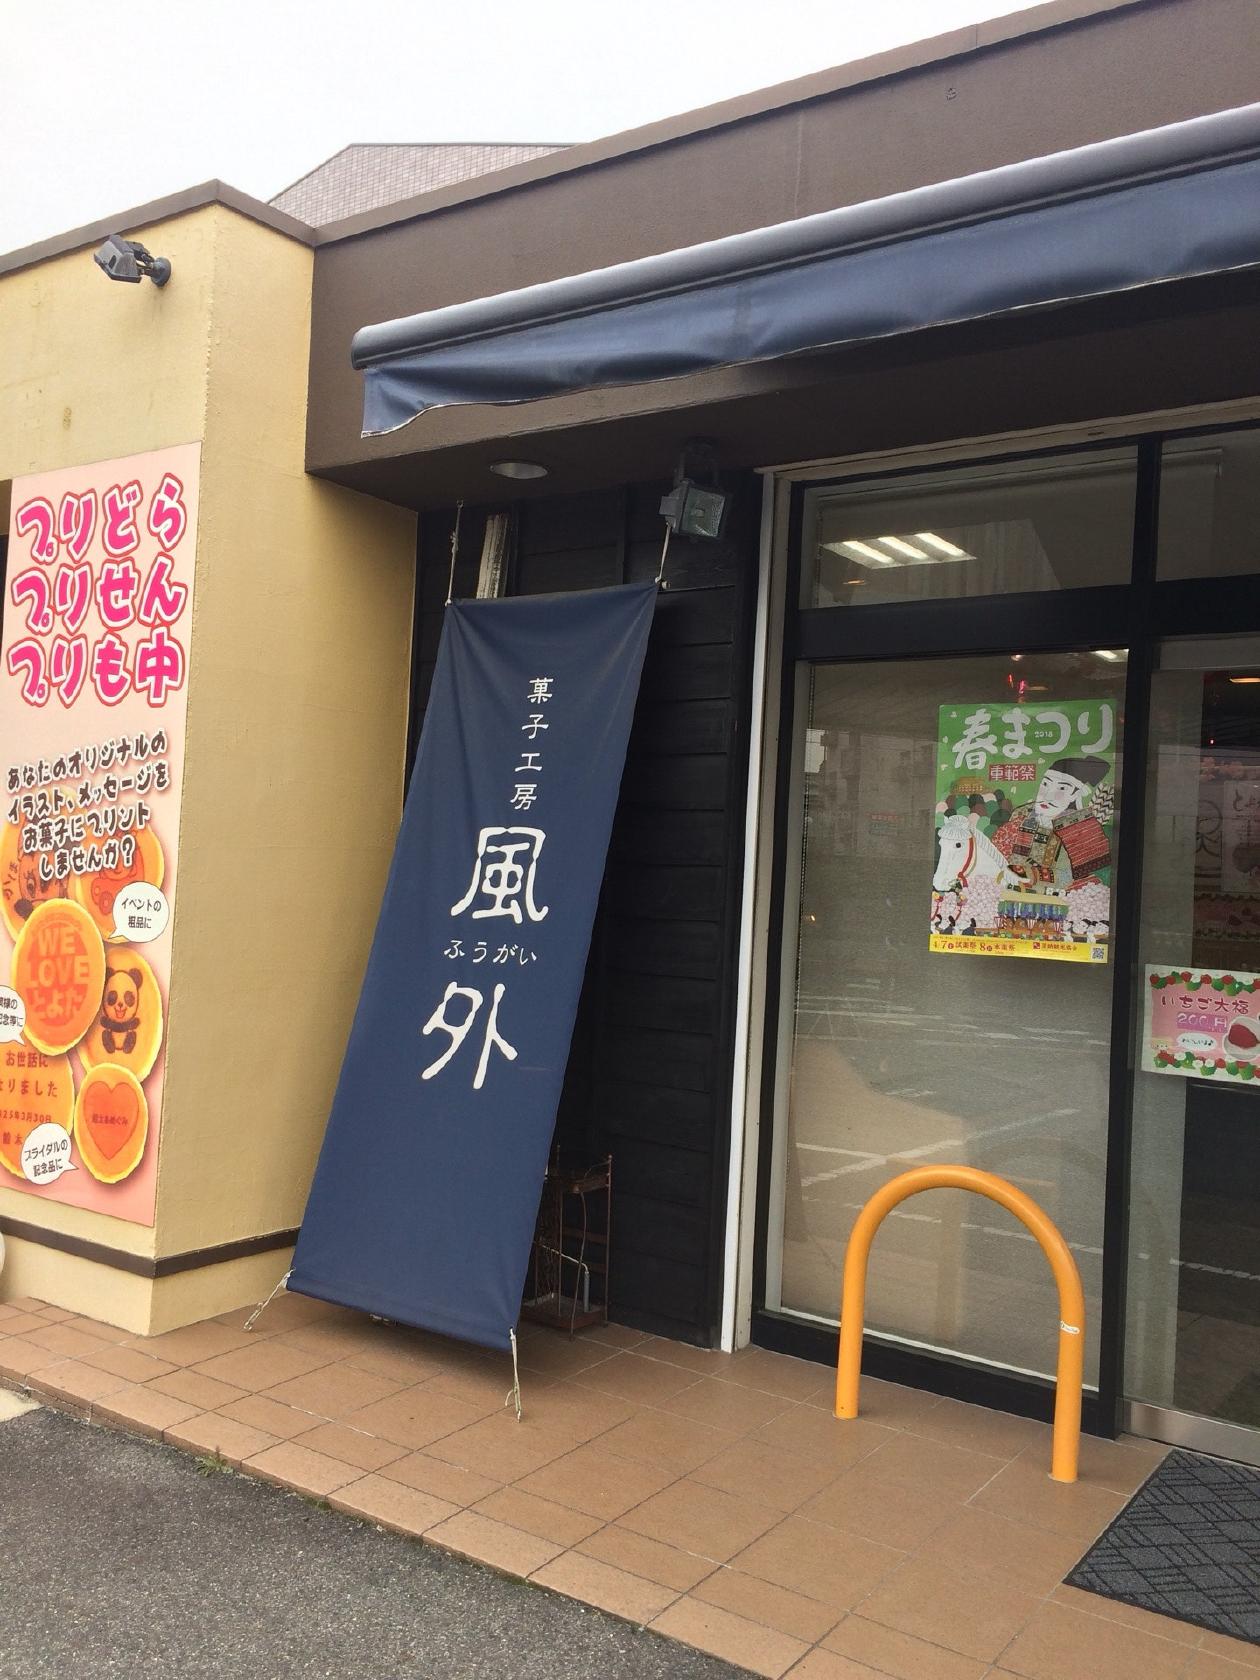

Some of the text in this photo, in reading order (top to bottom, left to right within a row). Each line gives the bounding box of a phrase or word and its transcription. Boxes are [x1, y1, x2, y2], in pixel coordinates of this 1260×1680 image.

[16, 472, 187, 565] プリどら
[11, 552, 188, 635] プリせん
[7, 623, 185, 709] プリも中
[7, 730, 167, 791] あなたのオリジナルの
[509, 677, 554, 811] 菓子工房
[951, 704, 1114, 770] 春まつり
[7, 762, 168, 822] イラスト、メッセージを
[23, 801, 149, 852] お菓子にプリント
[121, 898, 162, 912] イベントの
[450, 826, 549, 924] 風
[38, 927, 75, 956] WE
[128, 915, 152, 928] 粗品に
[27, 956, 90, 988] LOVE
[443, 940, 537, 965] ふうがい
[421, 981, 518, 1089] 外
[1161, 996, 1249, 1014] いちご大福
[6, 1051, 48, 1068] お世話に
